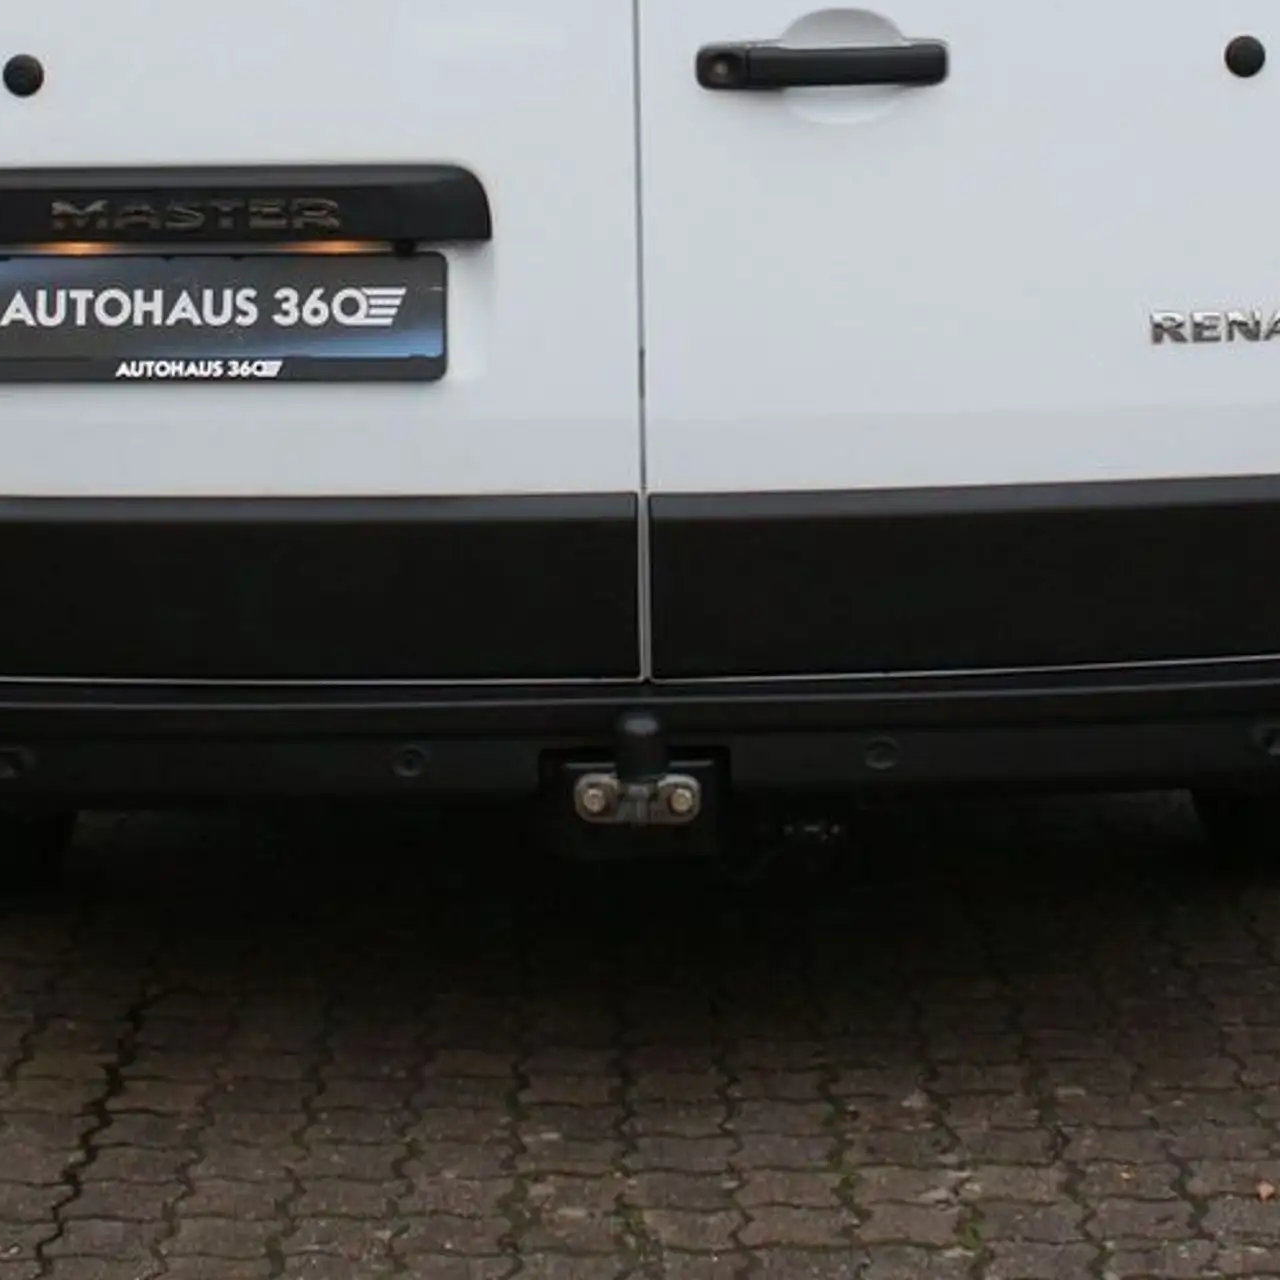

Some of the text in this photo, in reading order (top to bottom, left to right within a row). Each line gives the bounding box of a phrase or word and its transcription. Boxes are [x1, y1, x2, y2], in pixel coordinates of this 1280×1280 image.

[50, 198, 342, 231] MASTER
[0, 286, 406, 327] AUTOHAUS 360
[115, 360, 283, 378] AUTOHAUS 360
